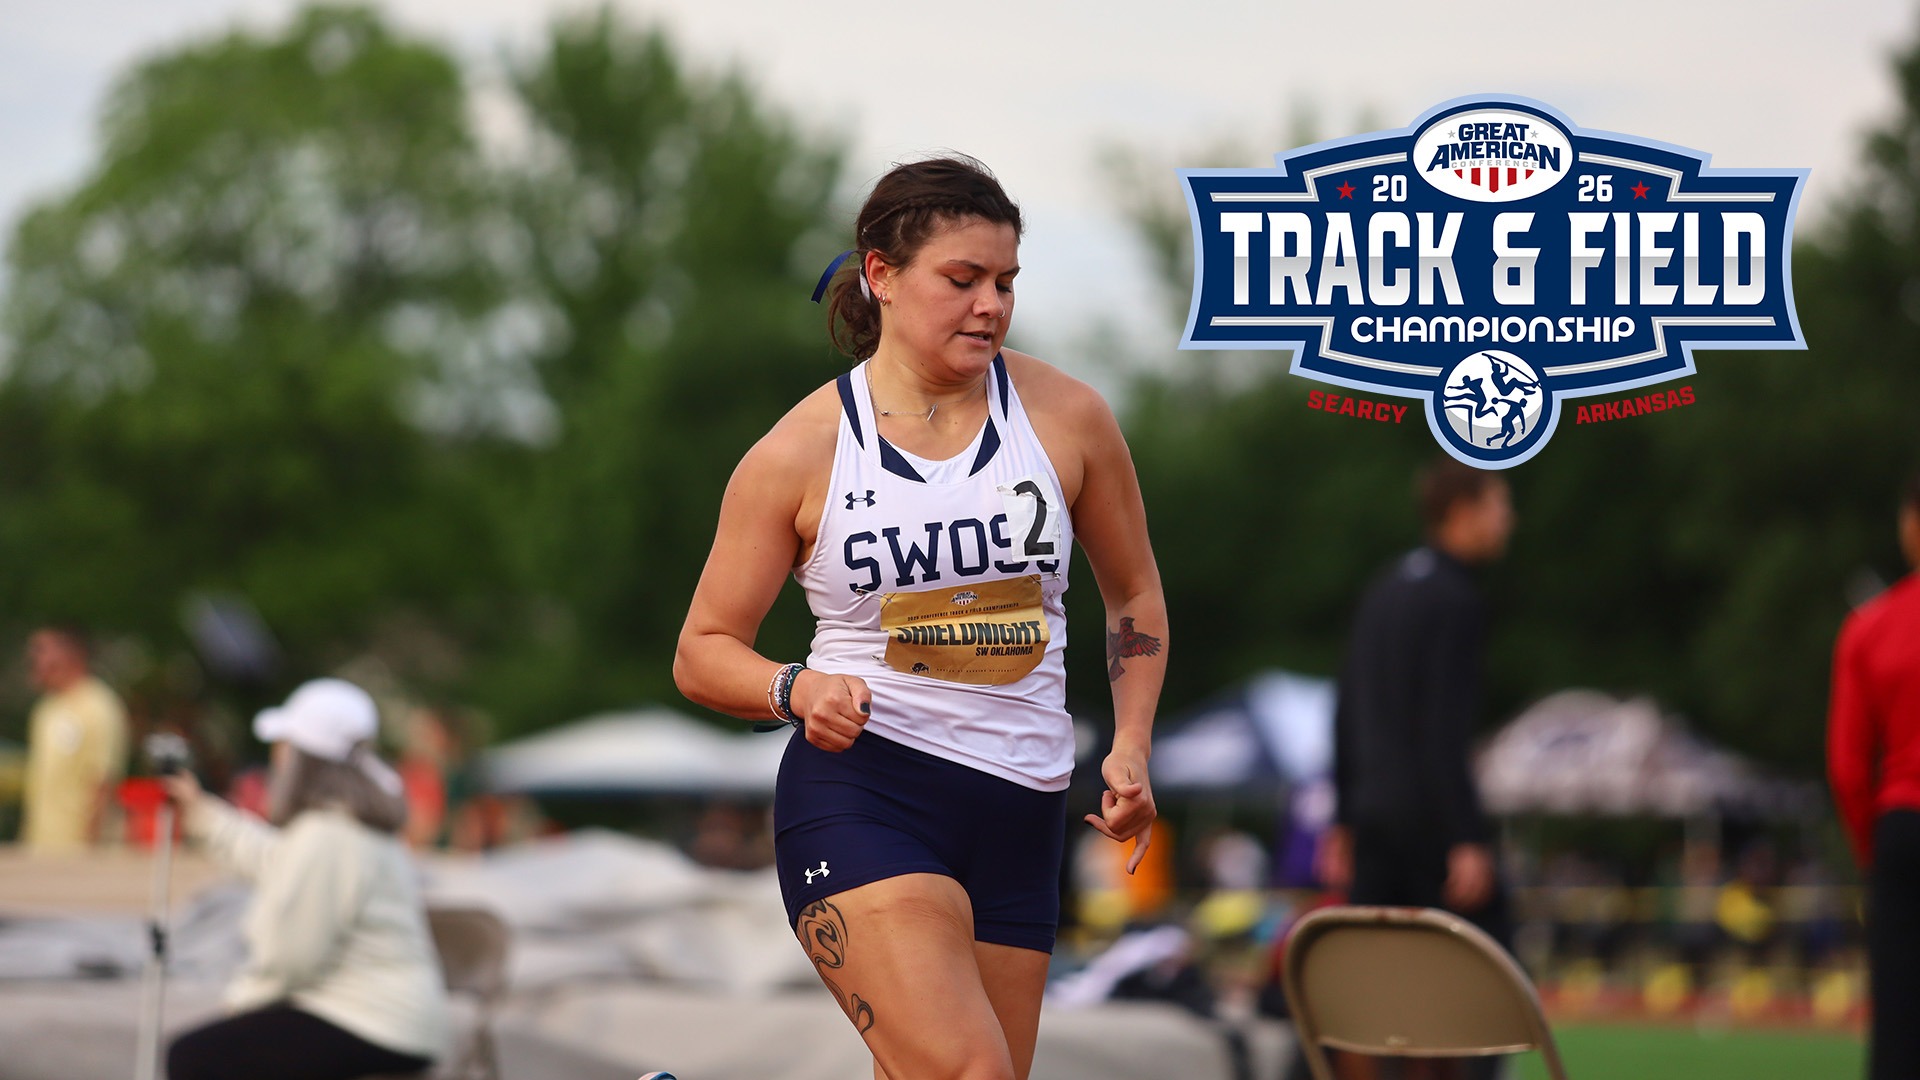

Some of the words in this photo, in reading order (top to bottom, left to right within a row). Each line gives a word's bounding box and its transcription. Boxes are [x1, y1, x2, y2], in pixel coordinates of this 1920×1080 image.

[1012, 480, 1055, 556] 2
[844, 513, 1059, 594] SWOS
[896, 620, 1042, 646] SHIELDNIGHT
[975, 646, 989, 657] SW
[990, 646, 1033, 656] OKLAHOMA
